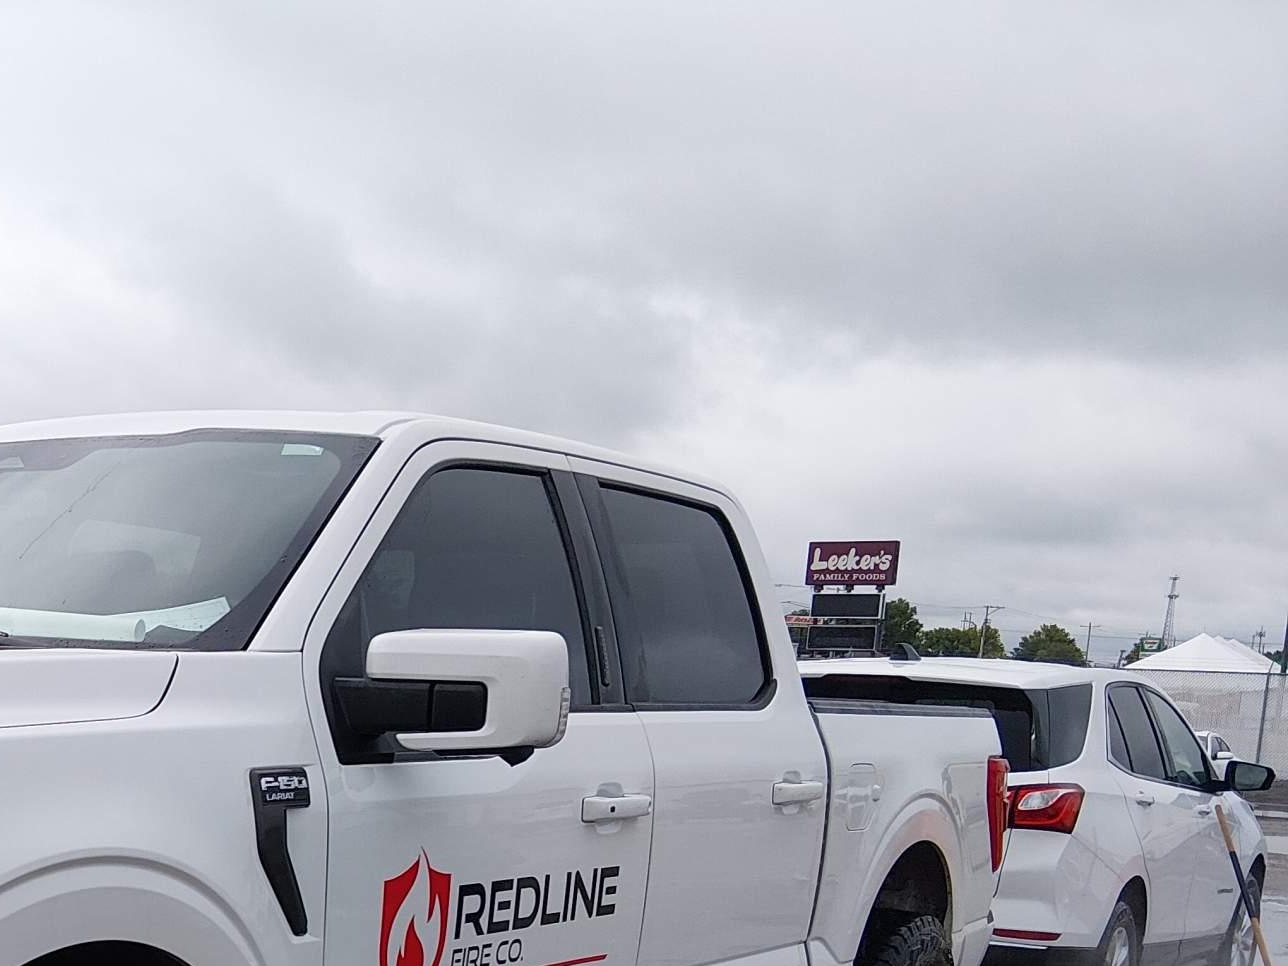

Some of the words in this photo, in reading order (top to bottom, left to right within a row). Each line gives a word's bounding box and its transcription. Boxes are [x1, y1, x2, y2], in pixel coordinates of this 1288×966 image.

[810, 548, 893, 571] Leeker's
[813, 573, 850, 581] FAMILY
[852, 573, 886, 581] FOODS
[454, 866, 620, 940] REDLINE
[495, 938, 524, 964] CO.
